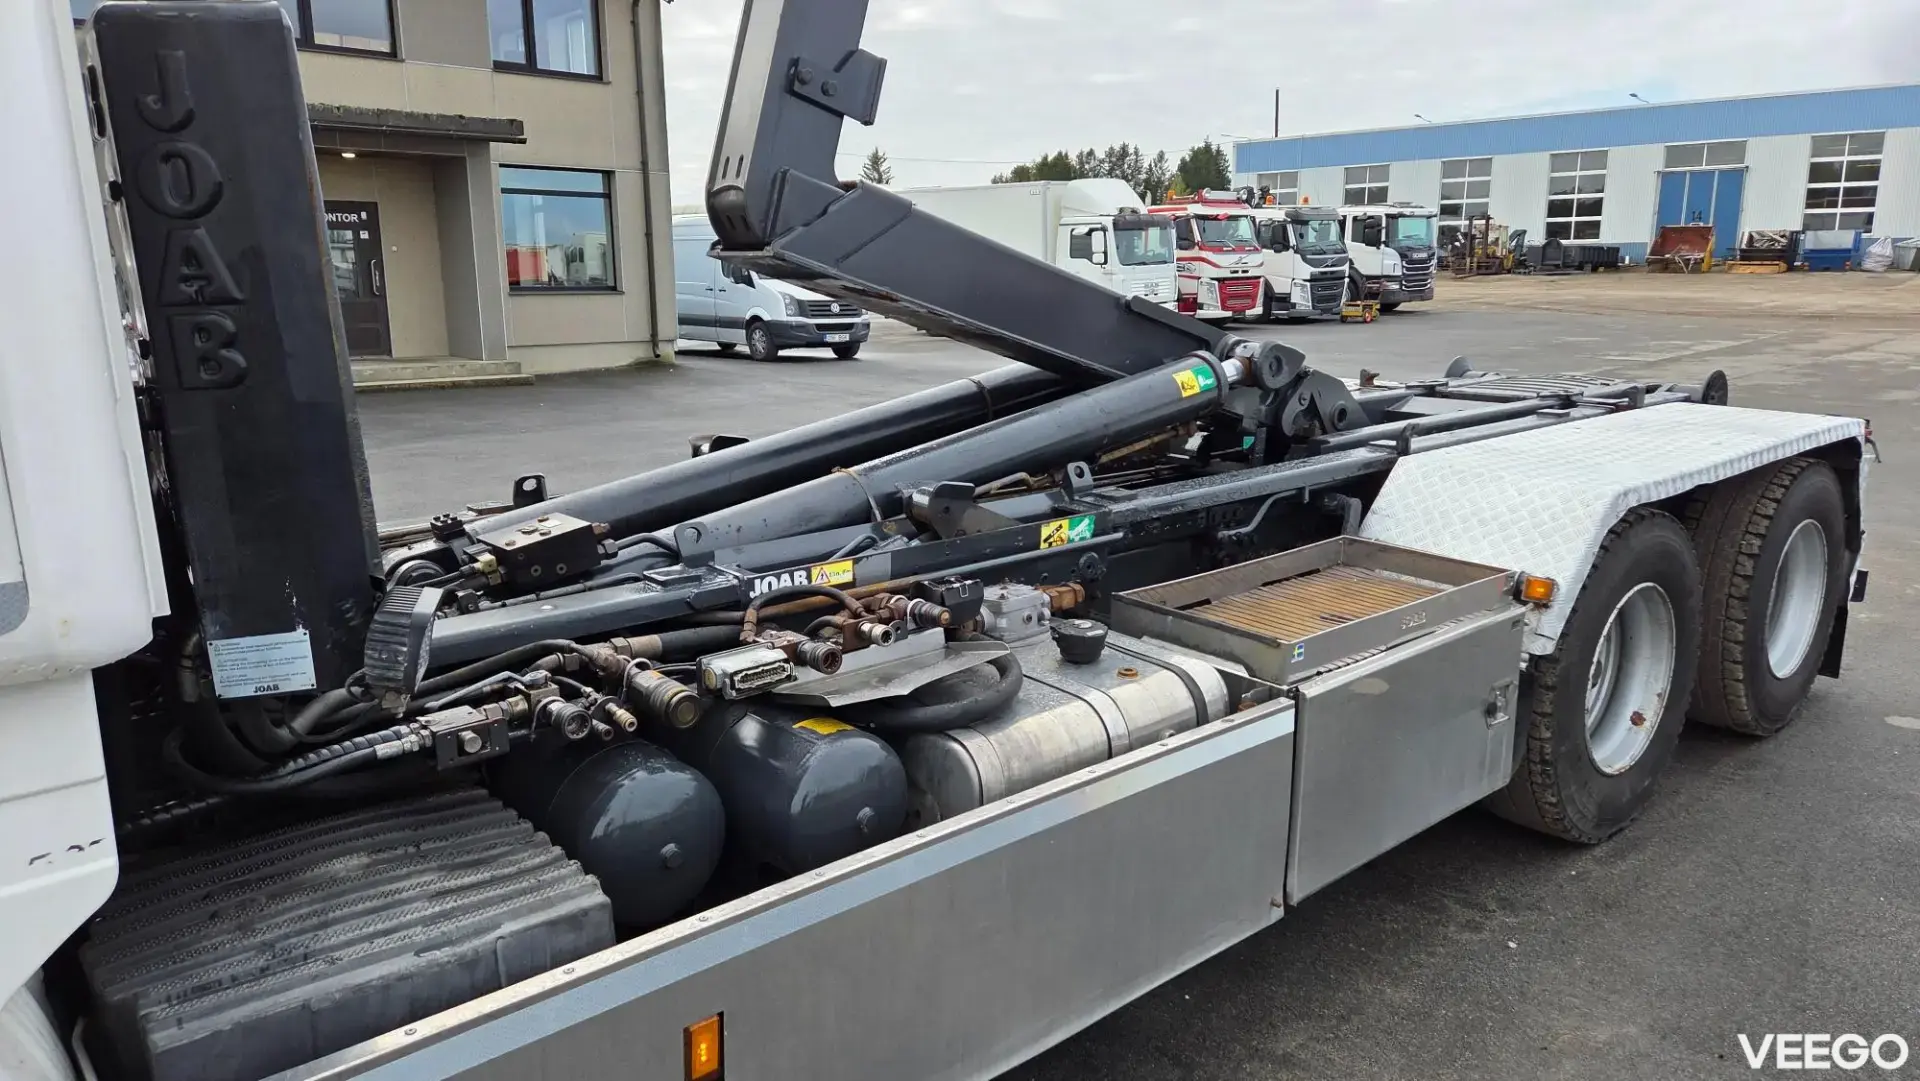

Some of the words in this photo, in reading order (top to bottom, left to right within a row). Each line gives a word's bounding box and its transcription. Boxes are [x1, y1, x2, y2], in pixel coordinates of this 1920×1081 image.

[135, 49, 248, 391] JOAB
[323, 212, 360, 223] ONTOR
[749, 570, 808, 598] JOAB
[253, 684, 280, 693] JOAB
